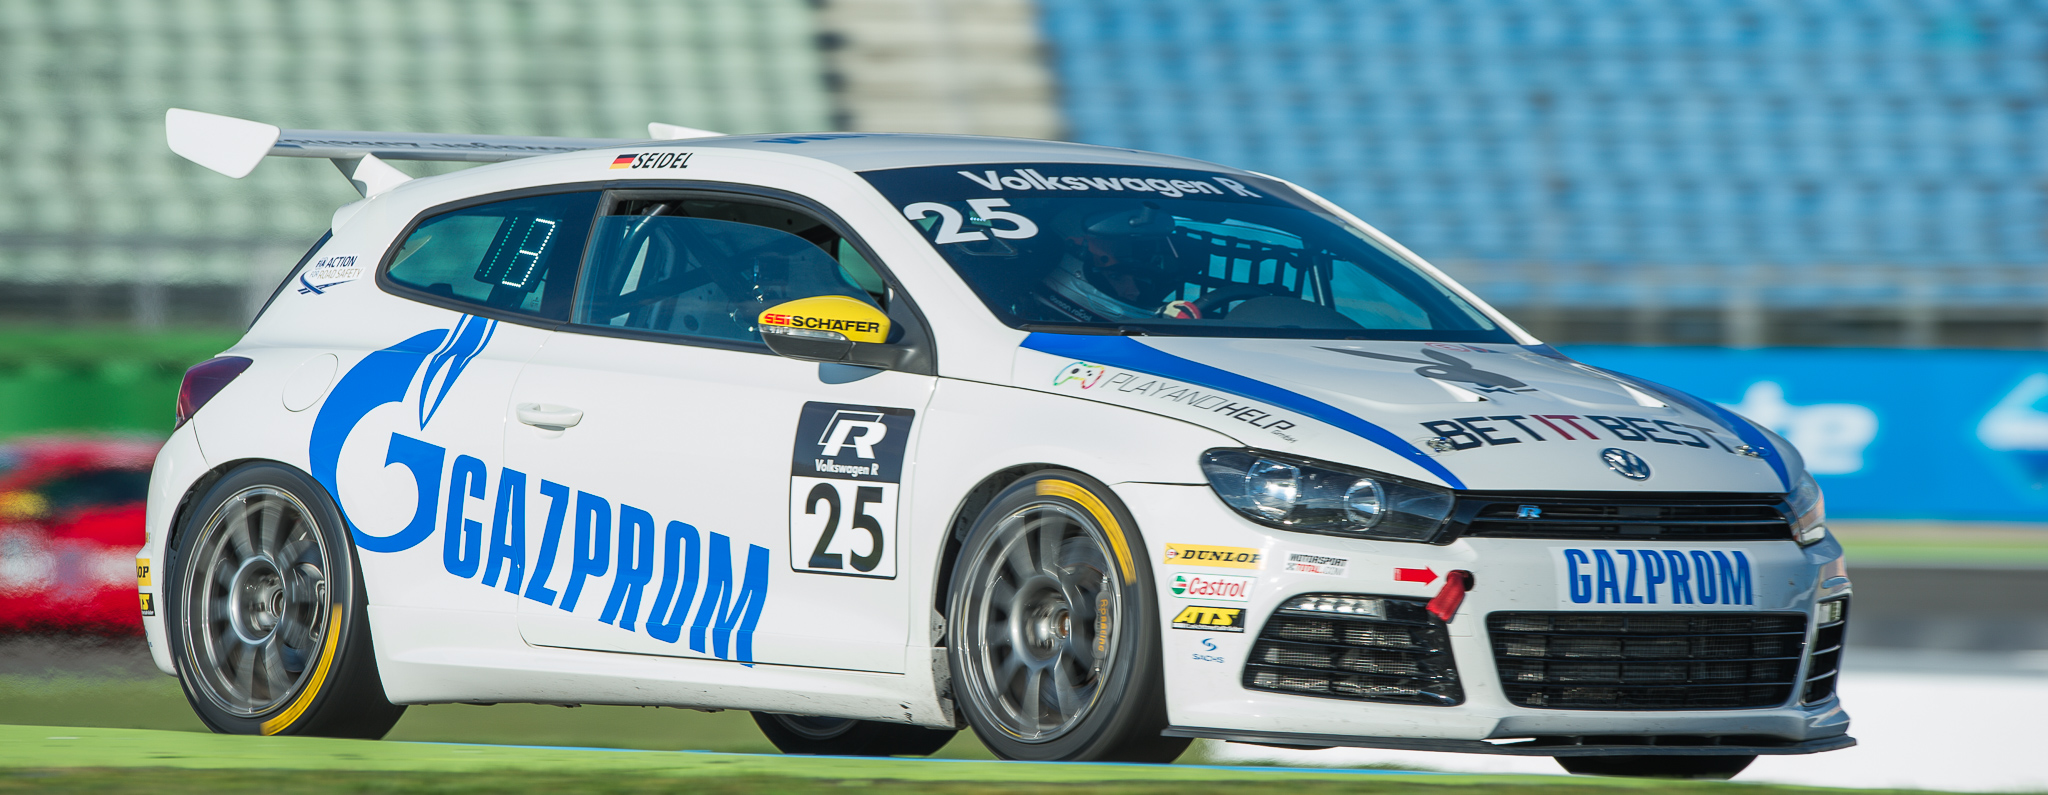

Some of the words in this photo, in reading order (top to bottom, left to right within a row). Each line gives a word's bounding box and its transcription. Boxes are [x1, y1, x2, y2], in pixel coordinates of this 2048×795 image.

[631, 152, 694, 169] SEIDEL
[957, 168, 1224, 199] Volkswagen
[1212, 176, 1263, 198] R
[902, 197, 1040, 245] 25
[325, 255, 359, 268] ACTION
[317, 268, 338, 280] ROAD
[335, 268, 364, 279] SAFETY
[792, 315, 880, 333] SCHÄFER
[817, 409, 887, 459] R
[814, 458, 870, 478] Volkswagen
[870, 462, 880, 476] R
[805, 482, 885, 573] 25
[442, 453, 770, 669] GAZPROM
[1181, 549, 1263, 564] DUNLOP
[1188, 577, 1247, 598] Castrol
[1563, 548, 1753, 606] GAZPROM
[1171, 605, 1241, 626] ATS
